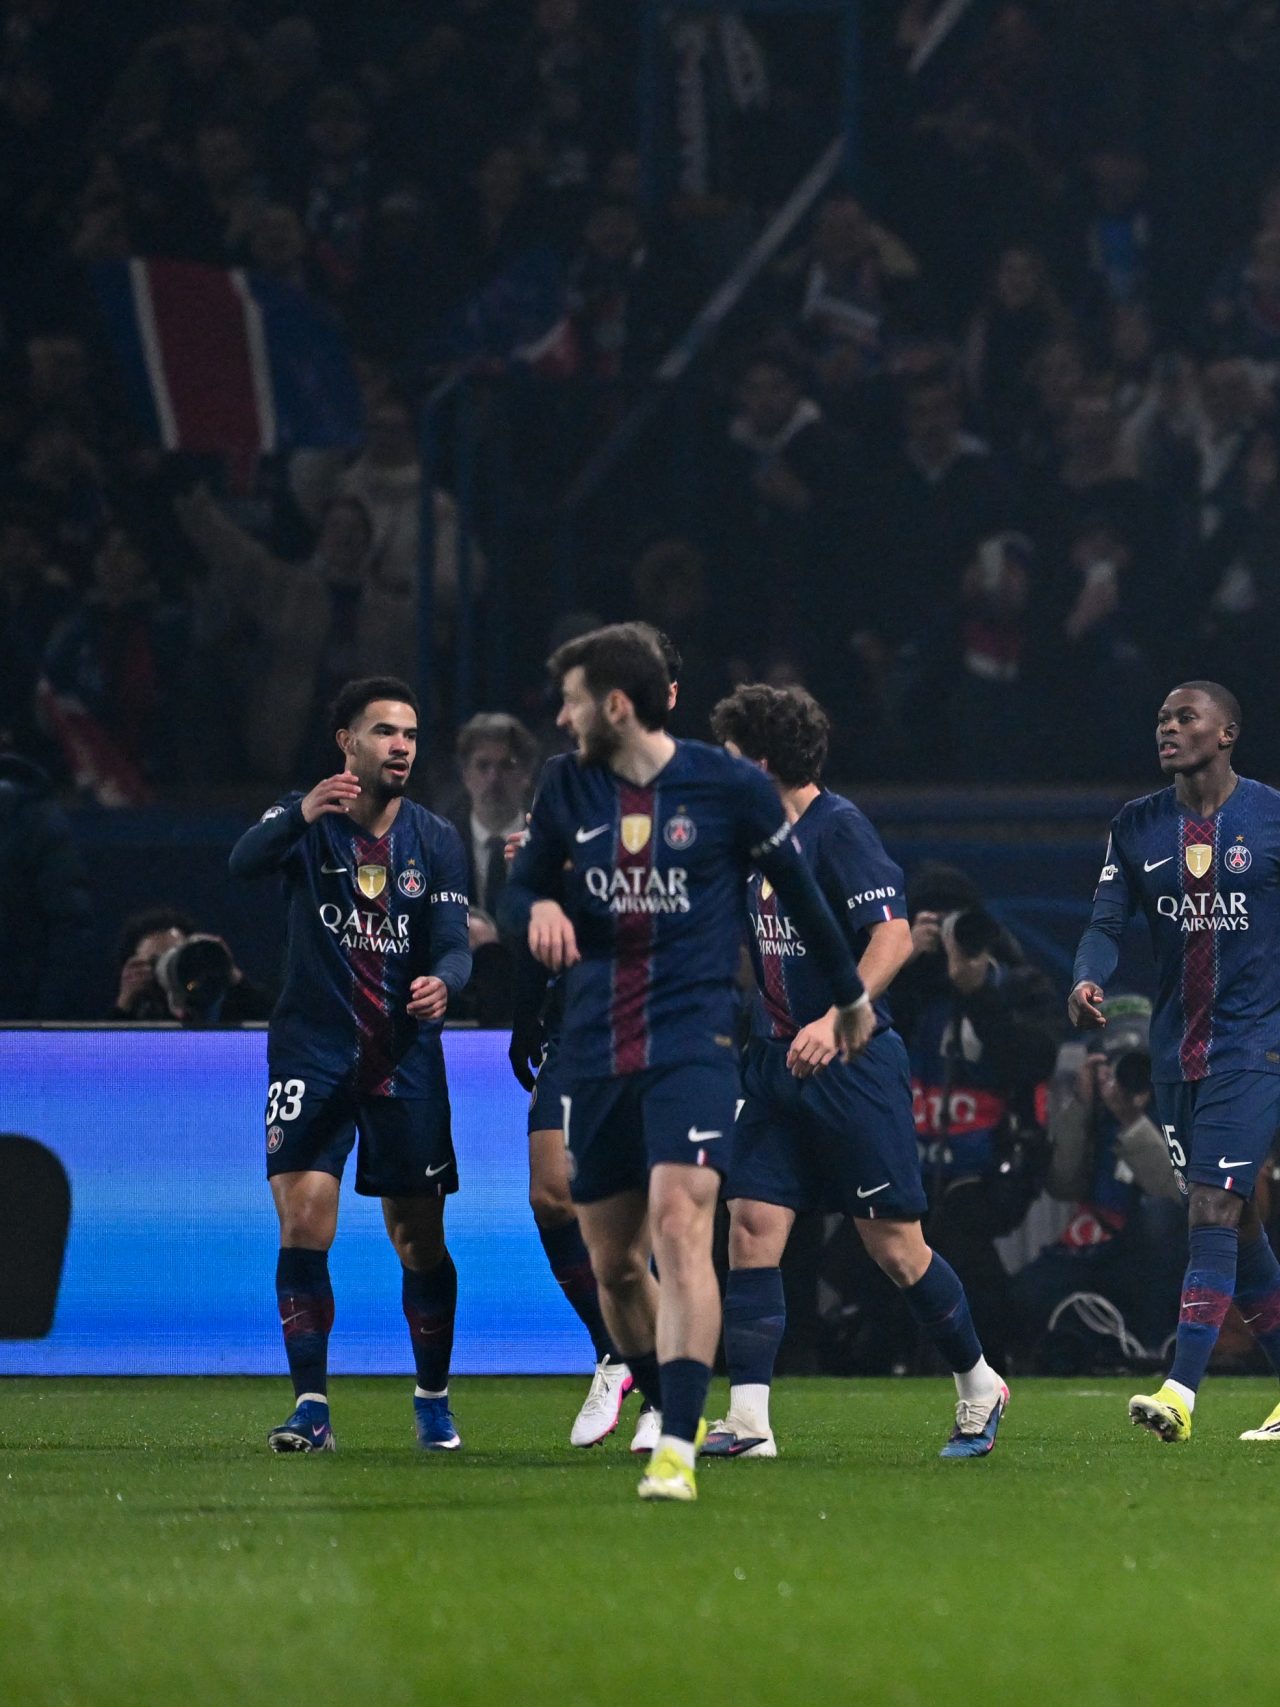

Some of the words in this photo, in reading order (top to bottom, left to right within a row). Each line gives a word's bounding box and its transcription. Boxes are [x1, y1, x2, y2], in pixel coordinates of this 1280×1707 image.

[586, 866, 689, 902] QATAR
[609, 895, 691, 914] AIRWAYS
[1157, 892, 1248, 922] QATAR
[319, 903, 410, 938] QATAR
[1180, 917, 1249, 932] AIRWAYS
[339, 933, 410, 954] AIRWAYS
[266, 1079, 306, 1126] 33
